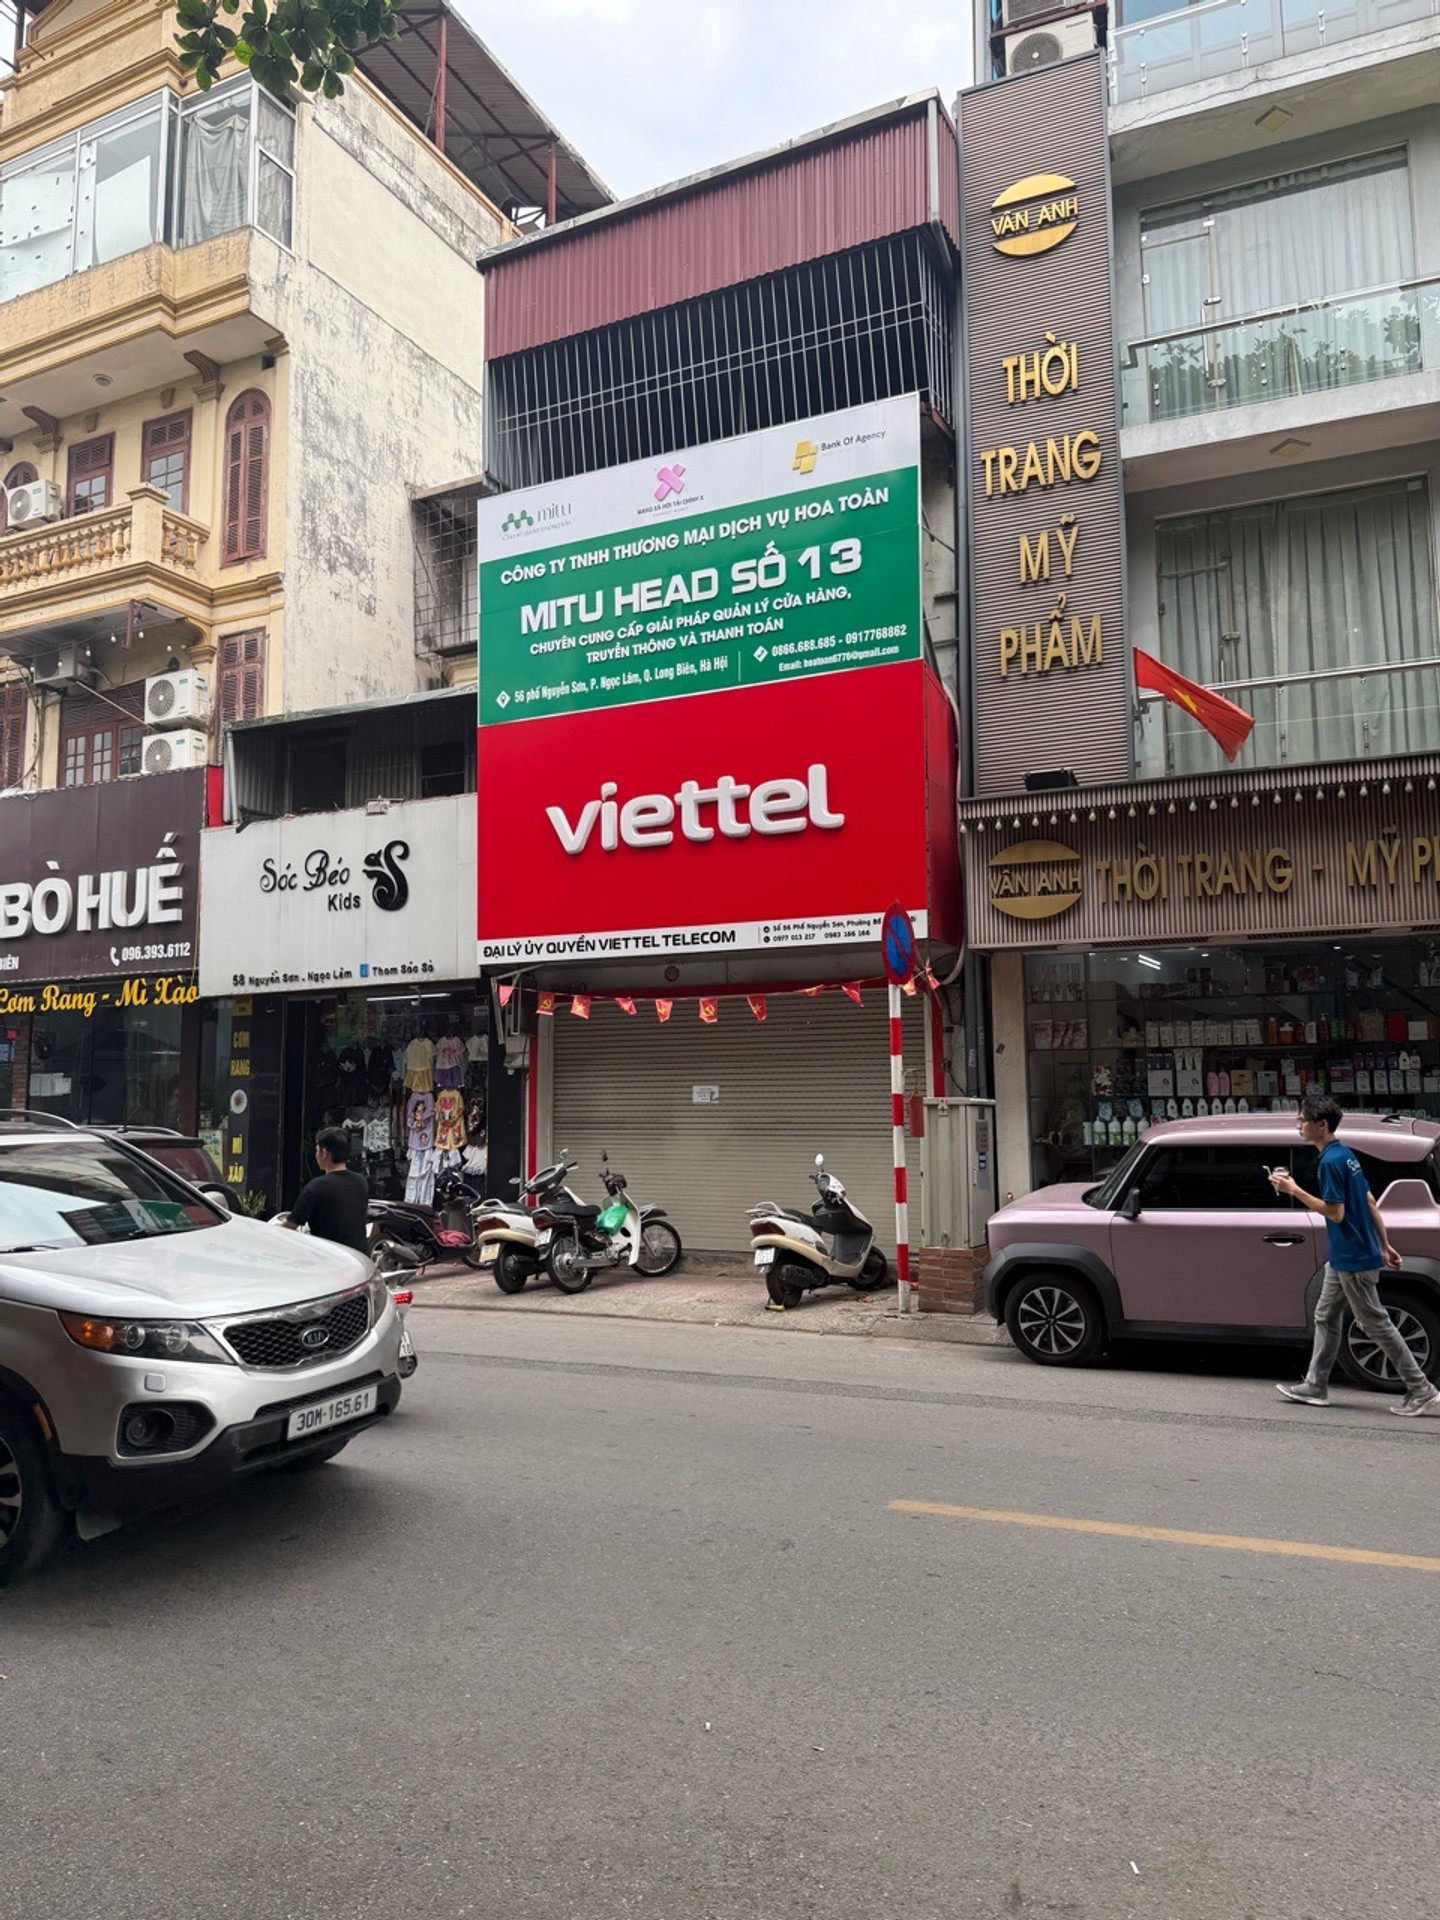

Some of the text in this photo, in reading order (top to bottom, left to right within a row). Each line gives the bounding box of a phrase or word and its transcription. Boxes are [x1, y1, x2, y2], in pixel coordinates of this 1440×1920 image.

[991, 197, 1079, 237] VÂN ANH
[1002, 332, 1079, 405] THỜI
[821, 430, 887, 451] Bank Of Agency
[980, 430, 1102, 496] TRANG
[537, 503, 571, 521] mitu
[501, 487, 889, 585] CÔNG TY TNHH THƯƠNG MẠI DỊCH VỤ HOA TOÀN
[1019, 513, 1079, 584] MỸ
[520, 590, 603, 635] MITU
[614, 567, 718, 617] HEAD
[731, 540, 786, 595] SỐ
[530, 585, 852, 655] CHUYÊN CUNG CẤP GIẢI PHÁP QUẢN LÝ CỬA HÀNG,
[586, 617, 784, 664] TRUYỀN THÔNG VÀ THANH TOÁN
[1000, 592, 1104, 677] PHẨM
[514, 690, 525, 703] 56
[526, 684, 540, 702] phố
[590, 677, 599, 691] P.
[600, 673, 620, 691] Ngọc
[643, 667, 653, 682] Q.
[654, 665, 675, 682] Long
[699, 657, 712, 672] Hà
[545, 763, 846, 855] viettel
[0, 832, 184, 938] BÒ HUẾ
[260, 849, 350, 893] Sóc Béo
[988, 869, 1028, 896] VÂN
[1036, 867, 1082, 895] ANH
[1096, 840, 1167, 903] THỜI
[1177, 847, 1293, 897] TRANG
[1346, 824, 1400, 887] MỸ
[328, 892, 361, 912] Kids
[121, 942, 191, 962] 096.393.6112
[483, 930, 736, 960] ĐẠI LÝ ỦY QUYỀN VIETTEL TELECOM
[40, 984, 97, 1017] Rang
[115, 978, 149, 1007] Mì
[153, 974, 200, 1005] Xào
[232, 974, 245, 986] 58
[307, 970, 331, 984] Ngọc
